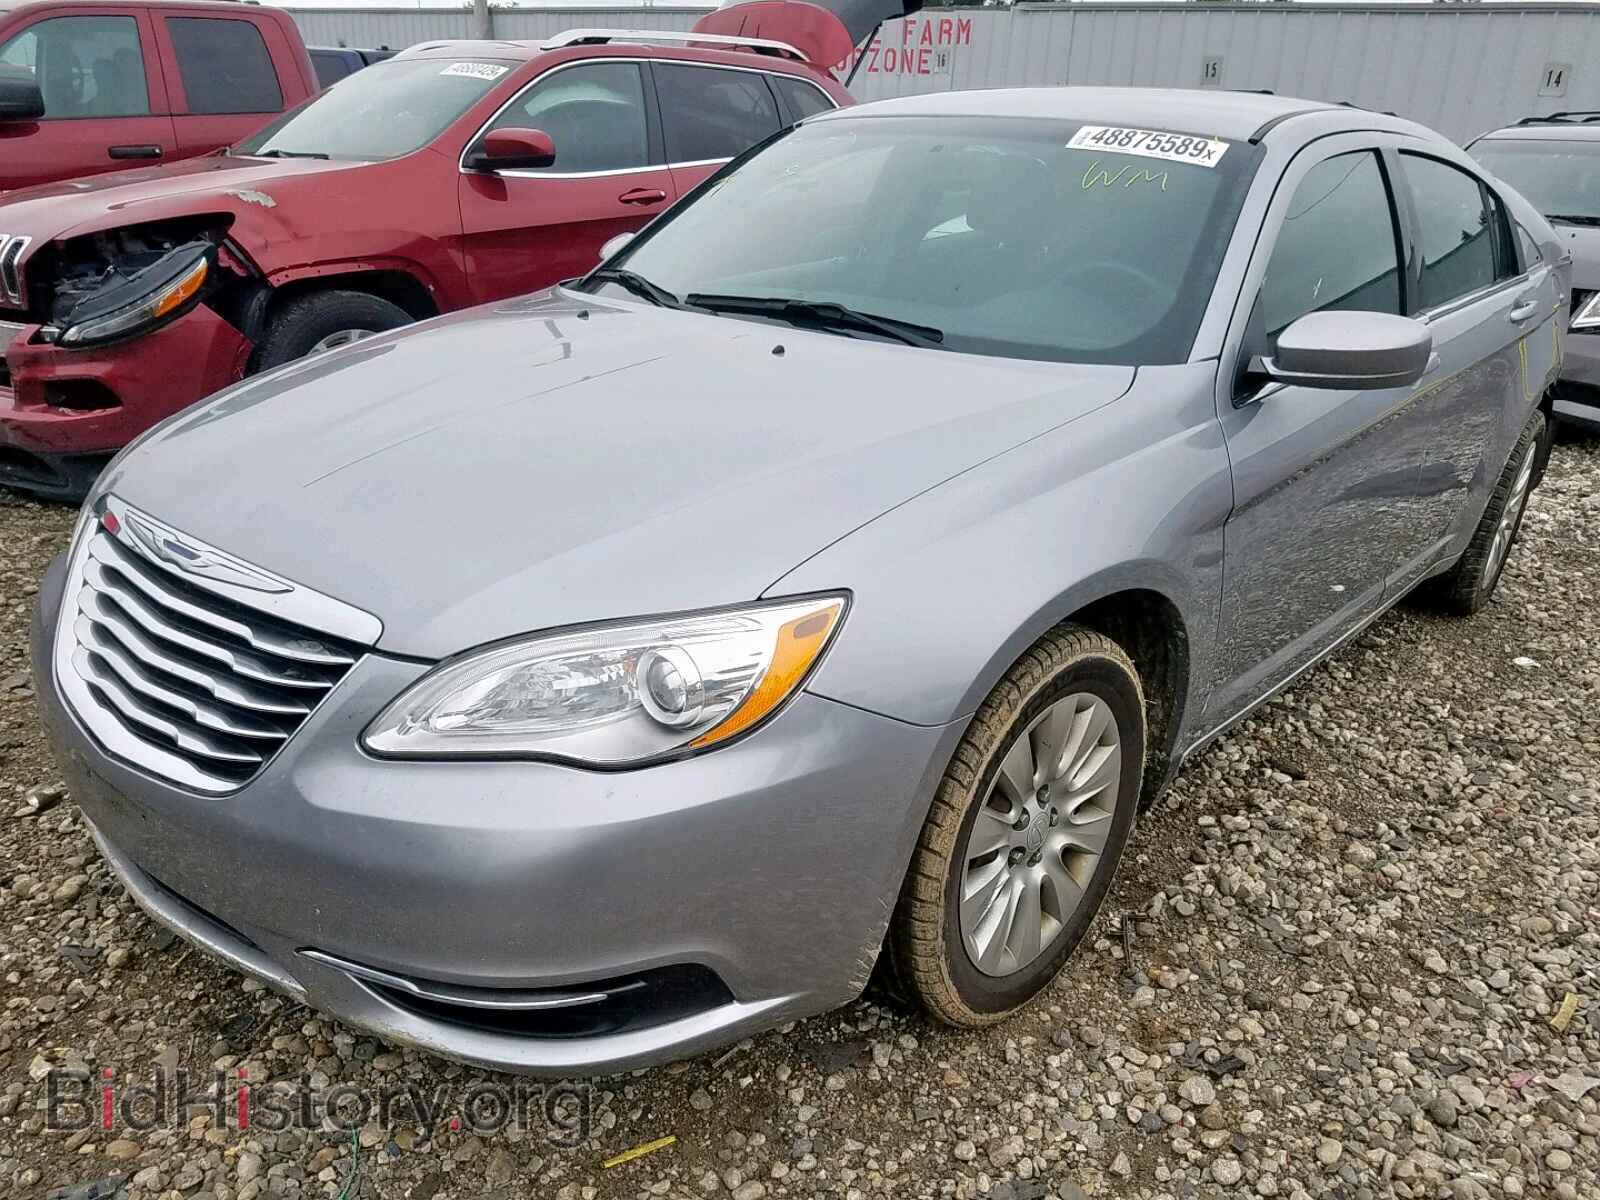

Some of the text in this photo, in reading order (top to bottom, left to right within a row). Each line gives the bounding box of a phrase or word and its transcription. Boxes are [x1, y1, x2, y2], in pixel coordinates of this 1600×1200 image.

[904, 19, 972, 45] FARM
[867, 48, 932, 74] ZONE
[1205, 62, 1217, 78] 15
[1546, 70, 1563, 88] 14
